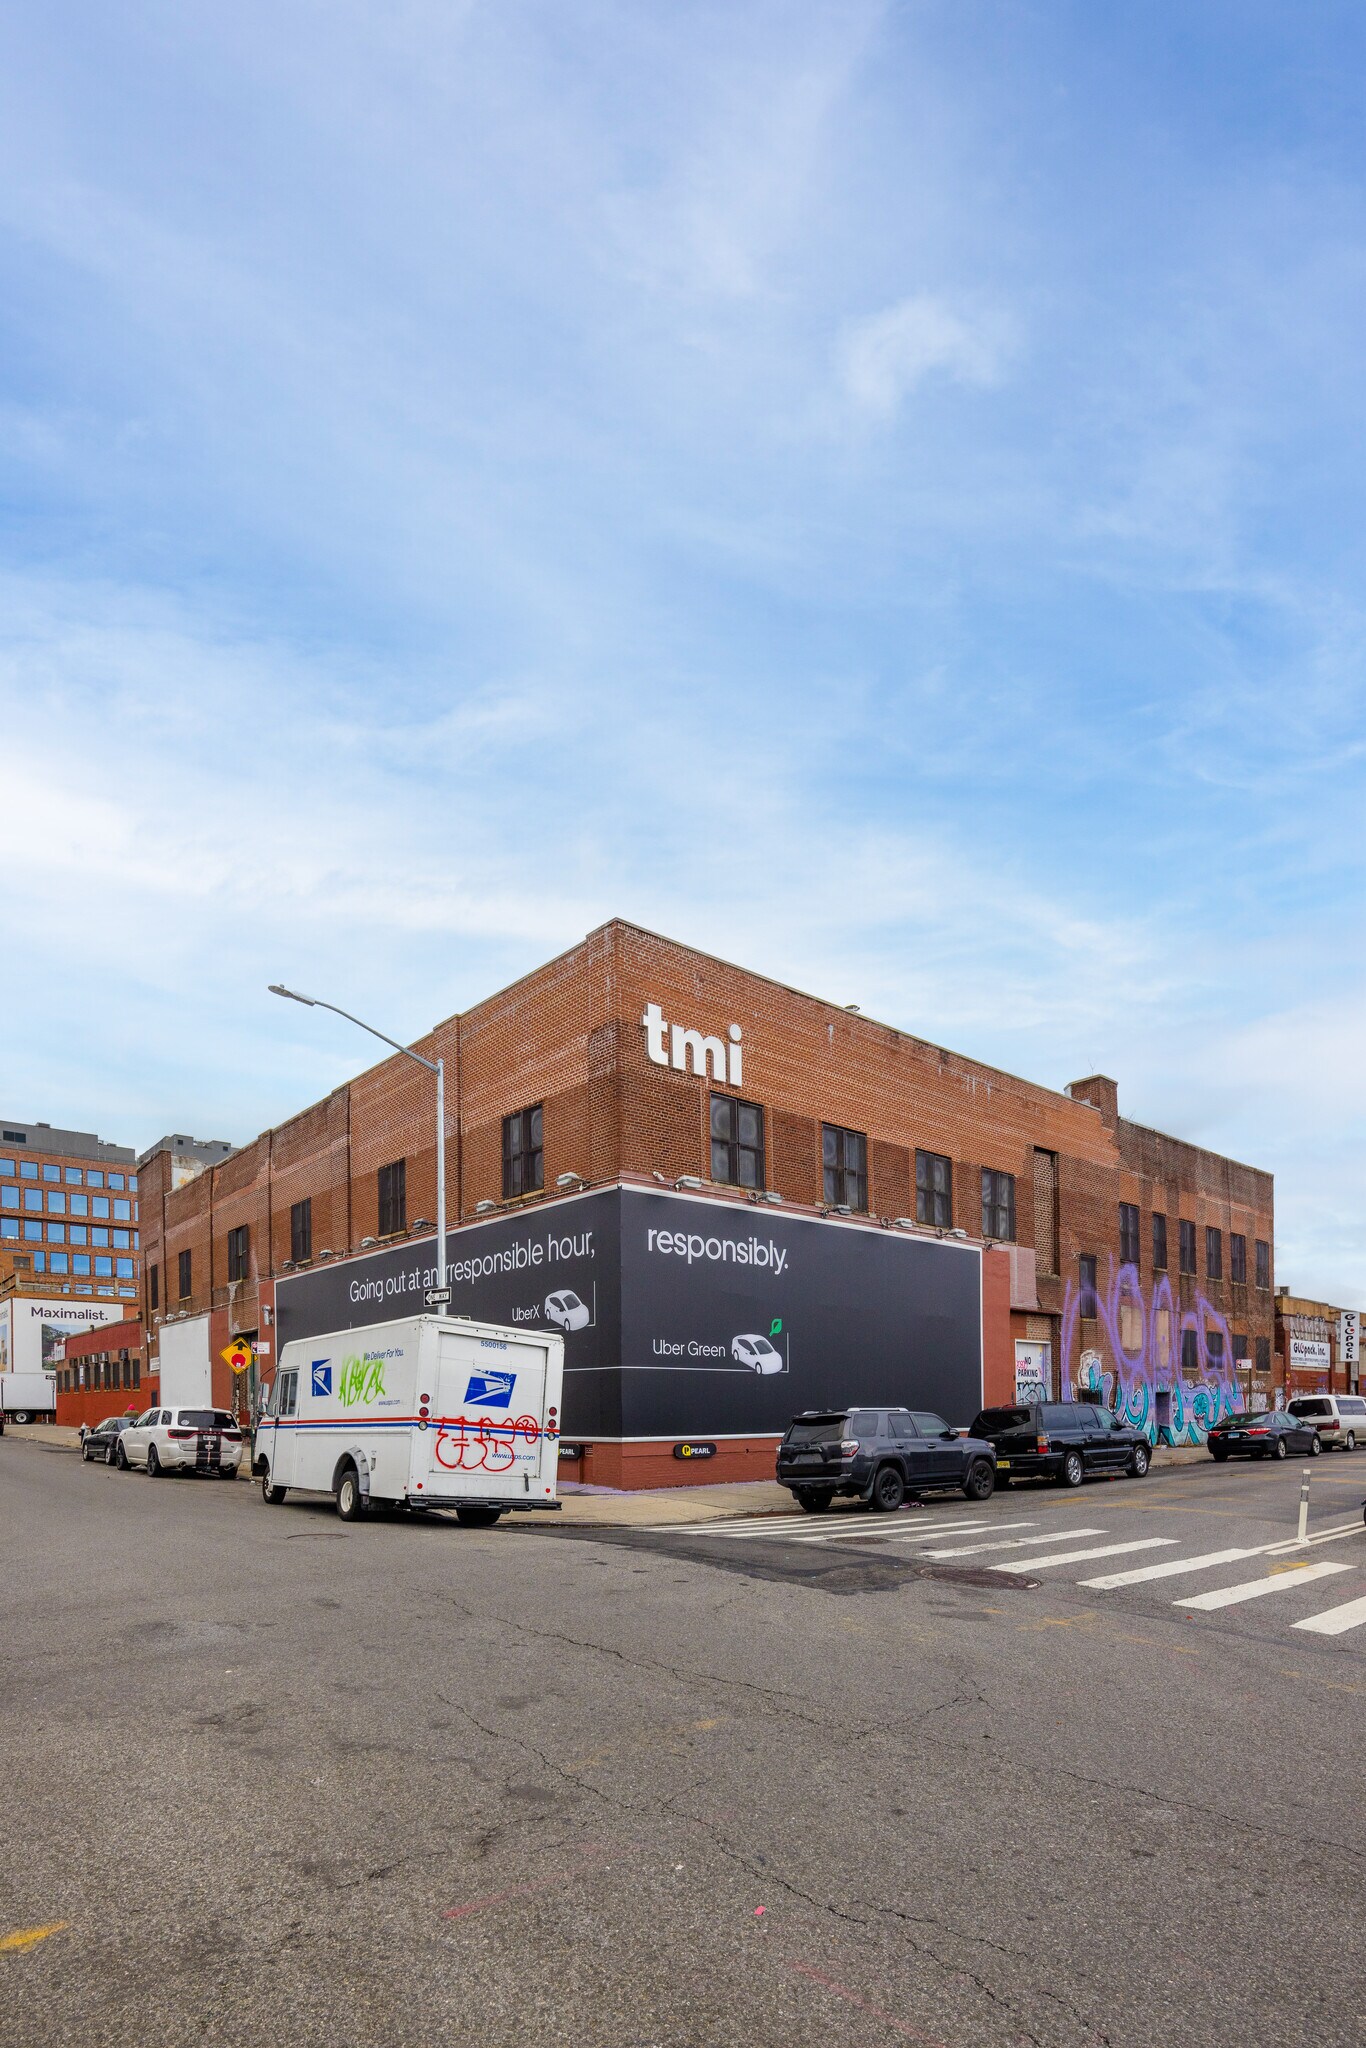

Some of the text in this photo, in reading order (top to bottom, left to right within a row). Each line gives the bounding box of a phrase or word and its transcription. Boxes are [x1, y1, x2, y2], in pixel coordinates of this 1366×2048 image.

[643, 1003, 742, 1087] tmi
[648, 1229, 788, 1275] responsibly.
[350, 1231, 595, 1303] Going out at an rresponsible hour,
[31, 1307, 108, 1320] Maximalist.
[512, 1304, 540, 1321] UberX
[370, 1351, 386, 1360] Deliver
[386, 1349, 394, 1358] For
[653, 1339, 725, 1357] Uber Green
[1018, 1369, 1038, 1377] PARKING
